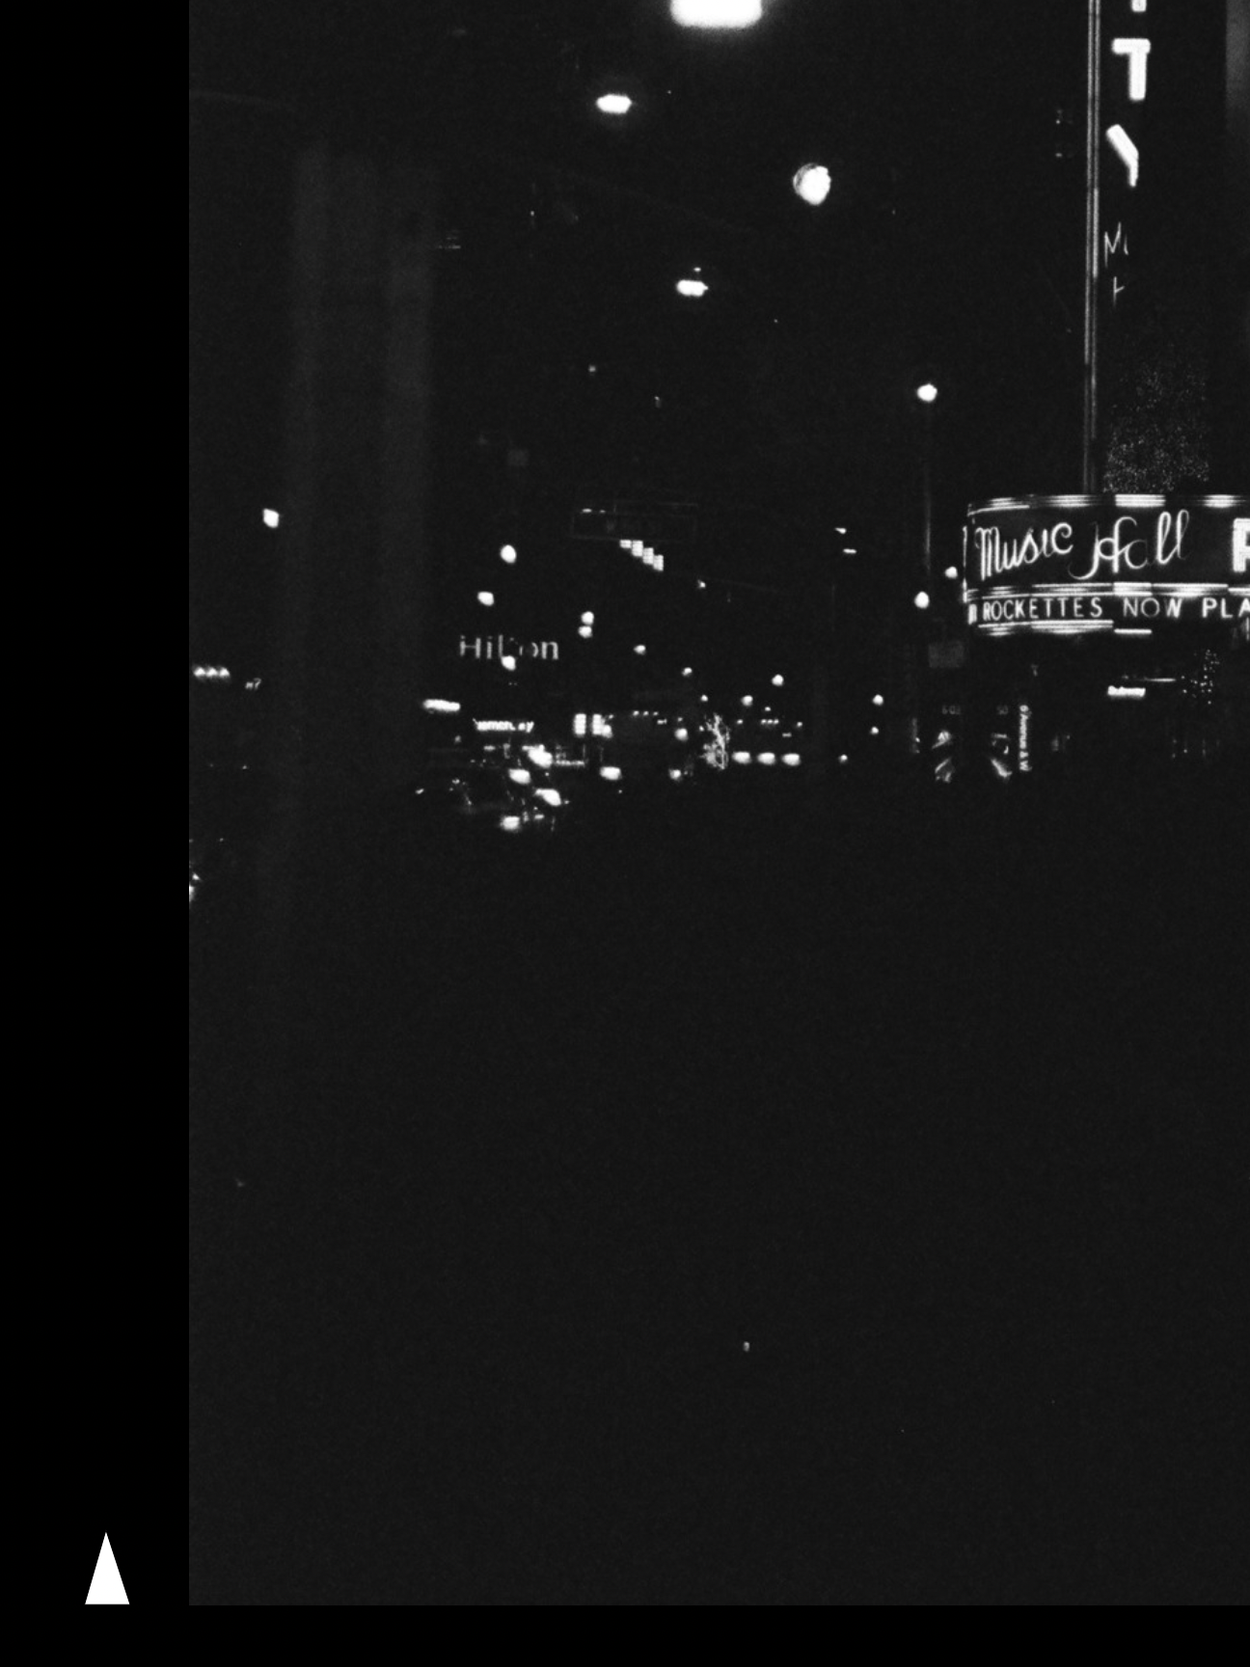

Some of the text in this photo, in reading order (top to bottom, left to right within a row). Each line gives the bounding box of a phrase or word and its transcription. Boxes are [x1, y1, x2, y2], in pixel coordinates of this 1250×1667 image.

[974, 522, 1074, 581] Music
[983, 597, 1103, 621] ROCKETTES
[1122, 596, 1183, 618] NOW
[460, 634, 559, 660] Hilon
